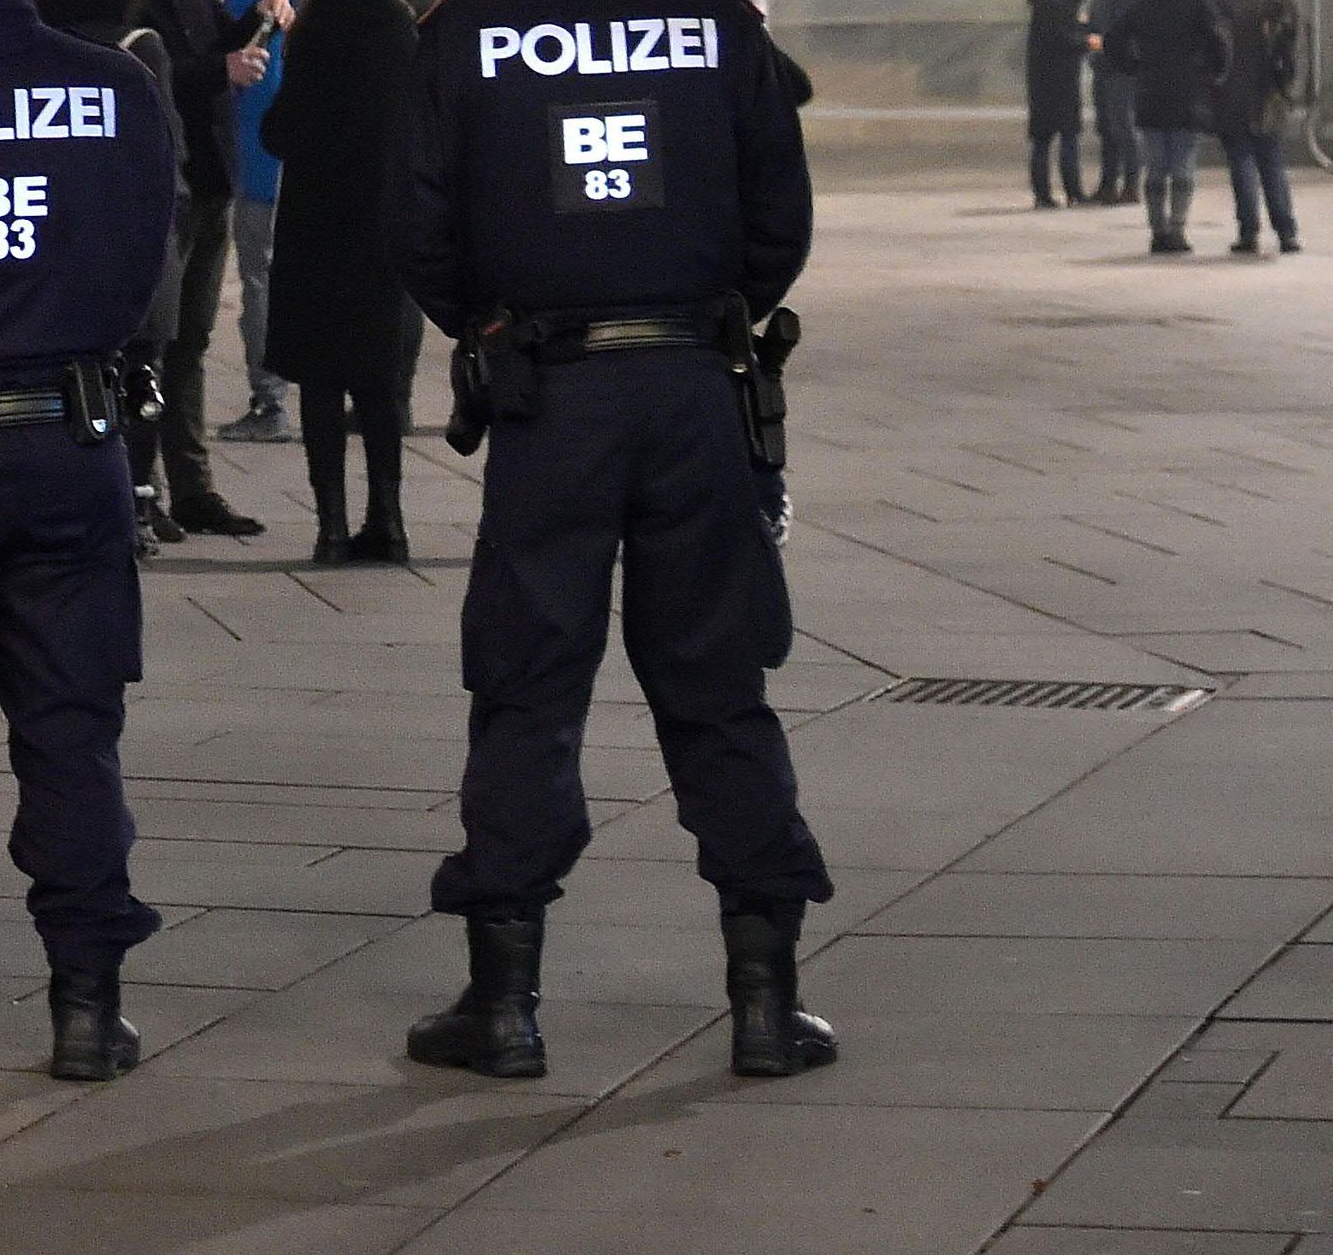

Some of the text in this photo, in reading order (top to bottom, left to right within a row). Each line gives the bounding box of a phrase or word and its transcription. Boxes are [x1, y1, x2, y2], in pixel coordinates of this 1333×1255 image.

[479, 18, 719, 78] POLIZEI
[562, 114, 649, 165] BE
[584, 168, 632, 200] 83
